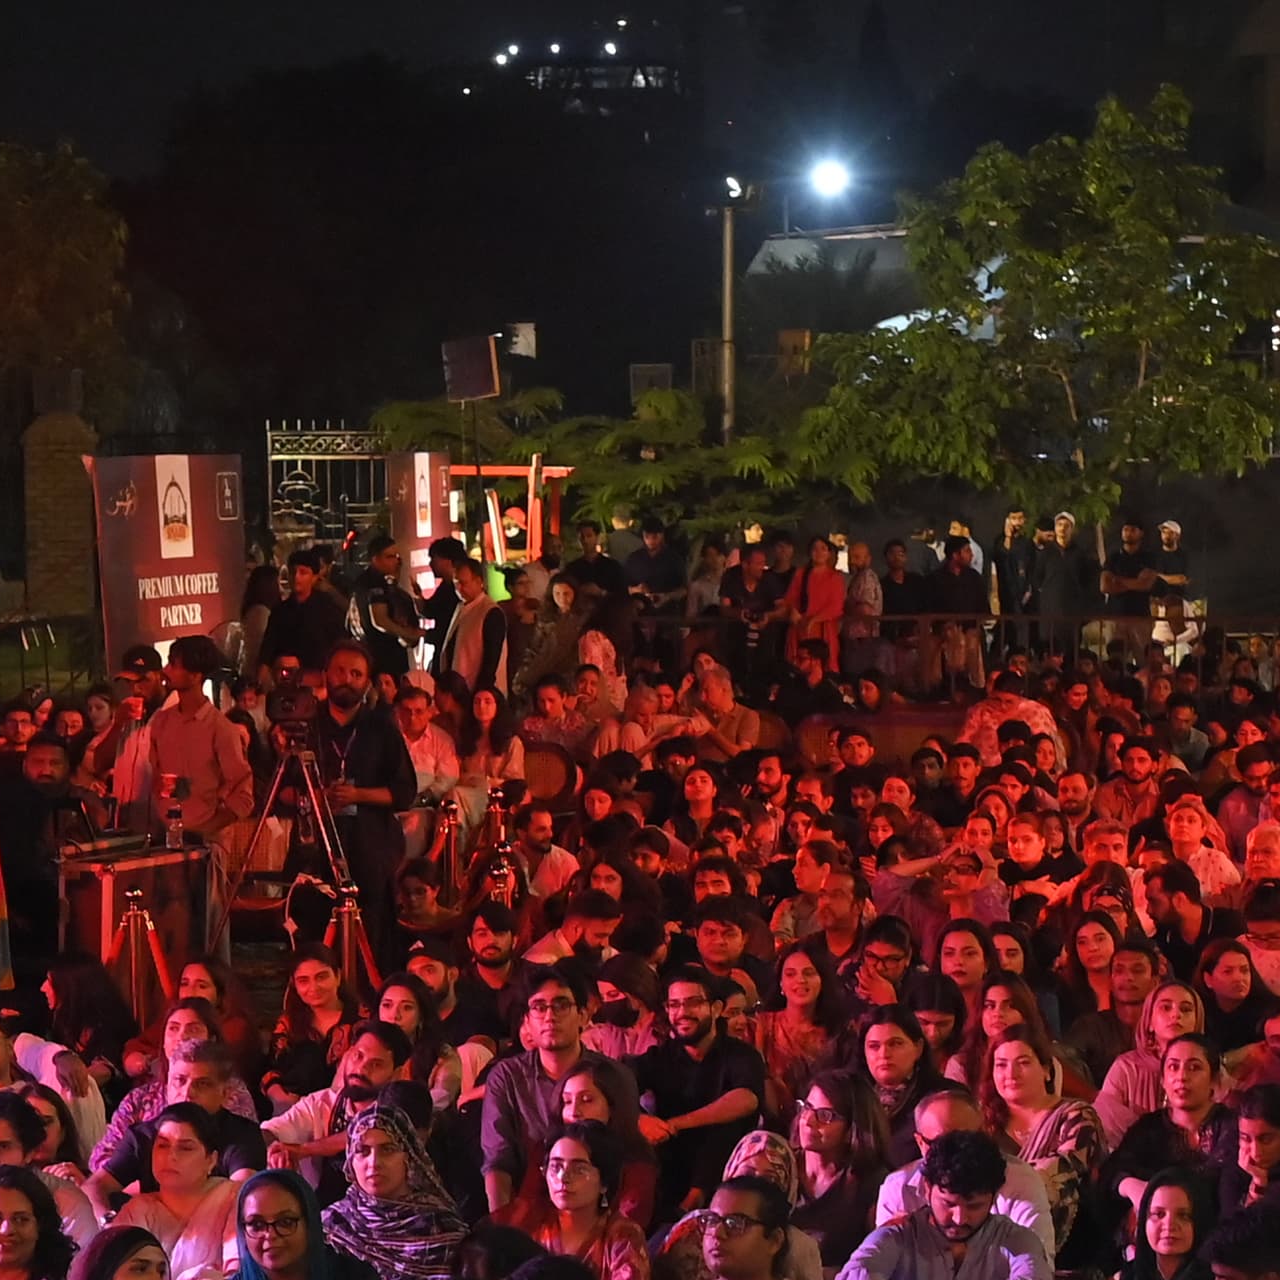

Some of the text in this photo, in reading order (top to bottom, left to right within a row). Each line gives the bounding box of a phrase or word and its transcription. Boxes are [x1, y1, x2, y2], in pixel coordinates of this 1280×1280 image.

[138, 572, 220, 600] PREMIUM COFFEE
[160, 603, 203, 628] PARTNER
